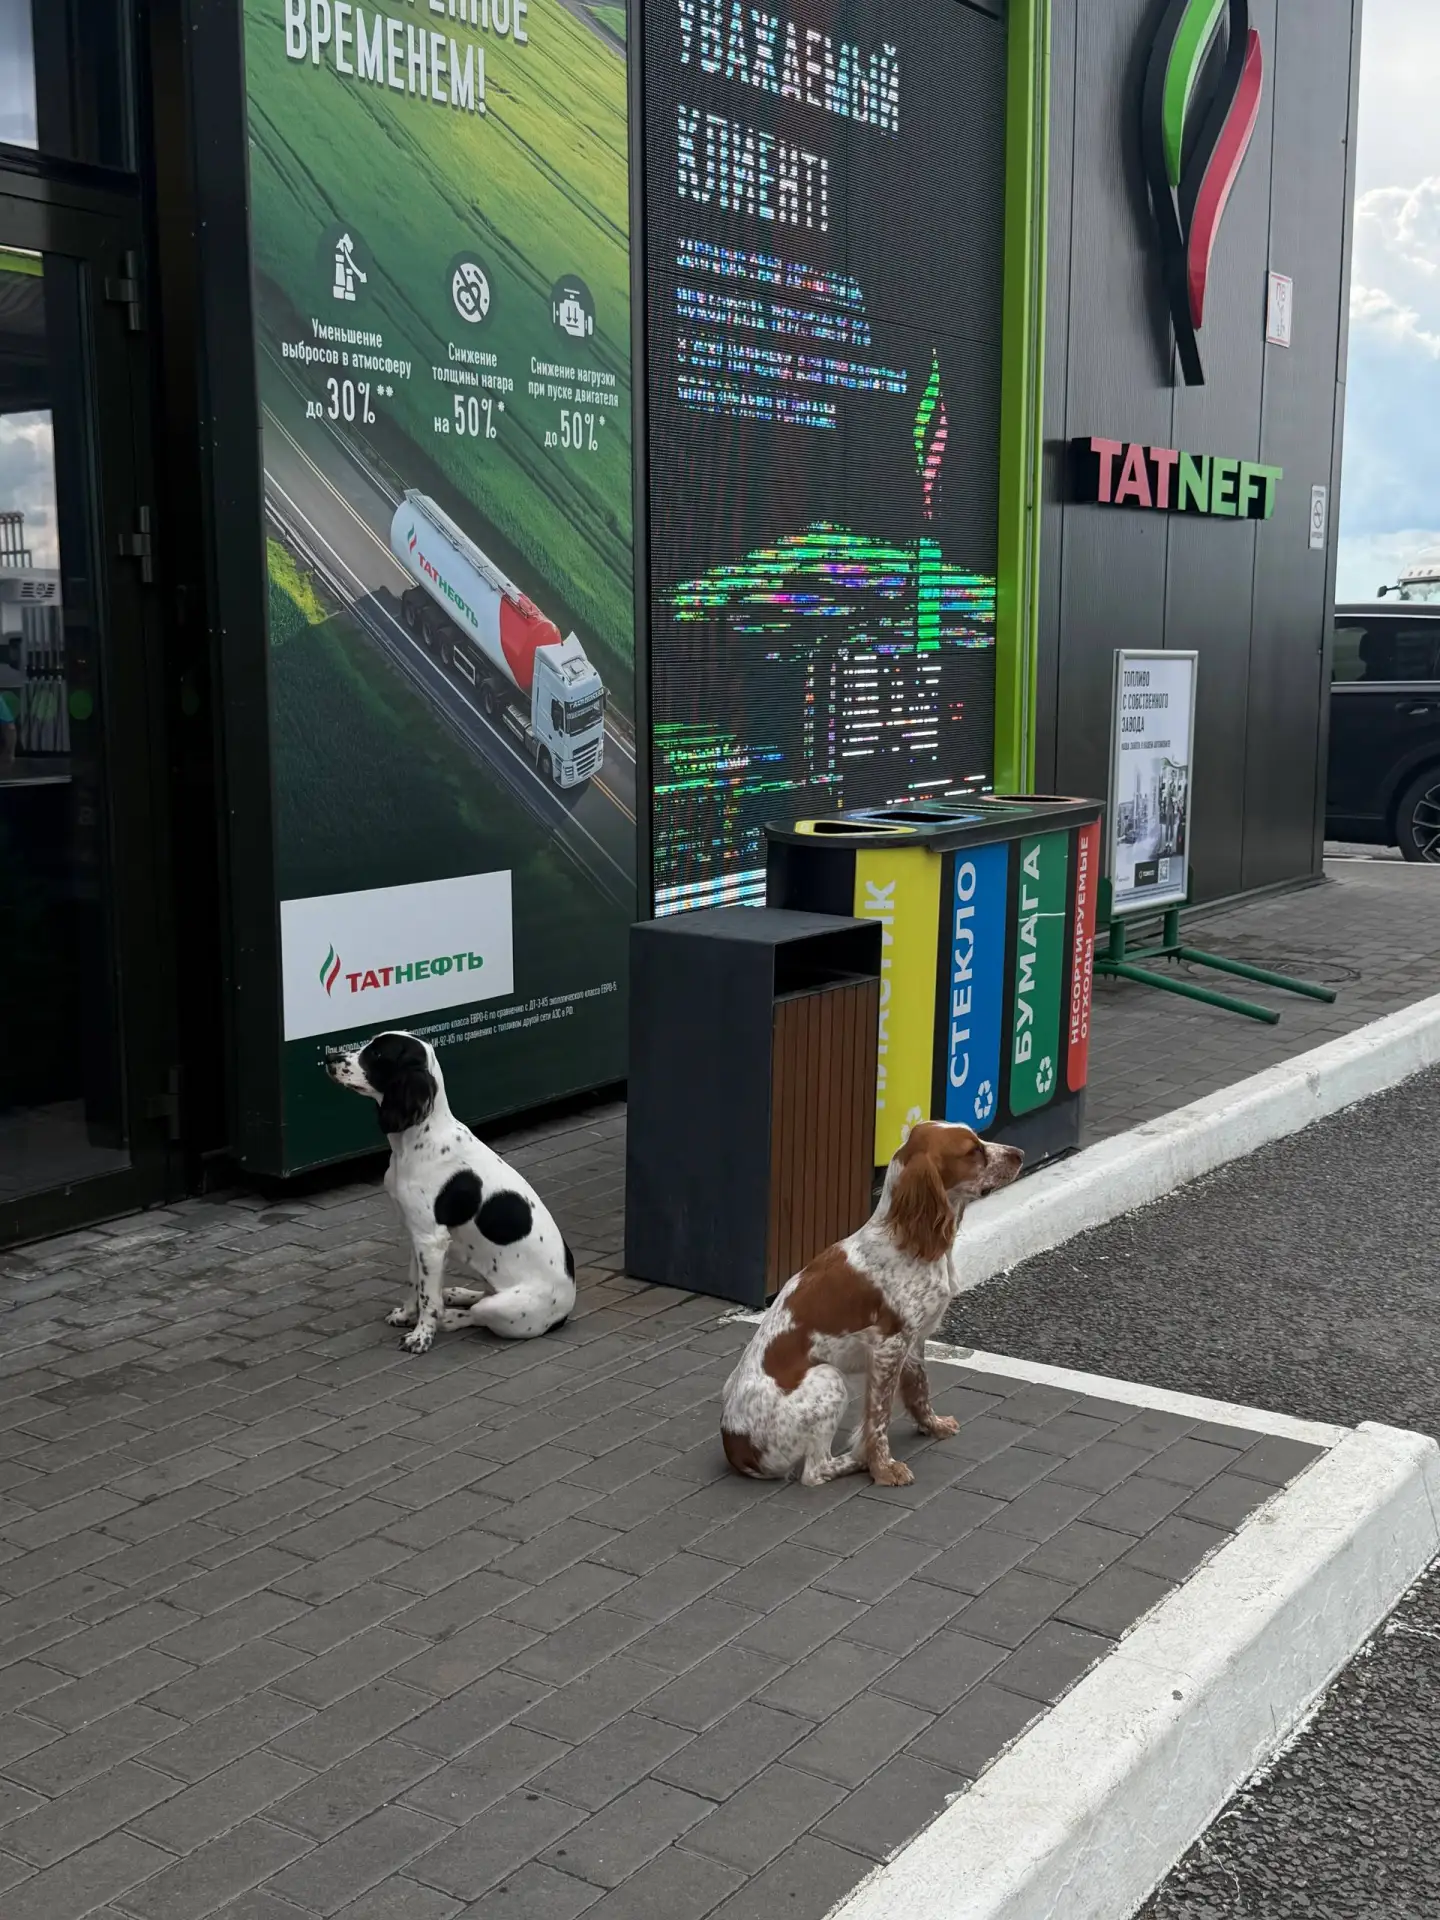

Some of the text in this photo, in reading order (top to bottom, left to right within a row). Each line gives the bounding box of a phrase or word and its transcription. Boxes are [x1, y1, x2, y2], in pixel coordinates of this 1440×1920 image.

[284, 0, 487, 113] ВРЕМЕНЕМ!
[311, 318, 383, 348] Уменьшение
[282, 341, 412, 379] выбросов в атмосферу
[448, 342, 497, 367] Снижение
[432, 366, 514, 394] толщины нагара
[531, 357, 616, 388] Снижение нагрузки
[528, 381, 619, 407] при пуске двигателя
[306, 401, 323, 419] до
[434, 416, 450, 433] на
[544, 431, 558, 447] до
[1091, 437, 1283, 520] TATNEFT
[417, 551, 479, 628] ТАТНЕФТЬ
[1124, 671, 1150, 687] ТОПЛИВО
[1123, 693, 1169, 710] С СОБСТВЕННОГО
[1121, 716, 1144, 734] ЗАВОДА
[1015, 844, 1041, 1064] БУМАГА
[1071, 836, 1089, 1044] НЕСОРТИРУЕМЫЕ
[345, 951, 484, 993] ТАТНЕФТЬ
[950, 862, 976, 1088] СТЕКЛО
[1080, 938, 1092, 1039] ОТХОДЫ
